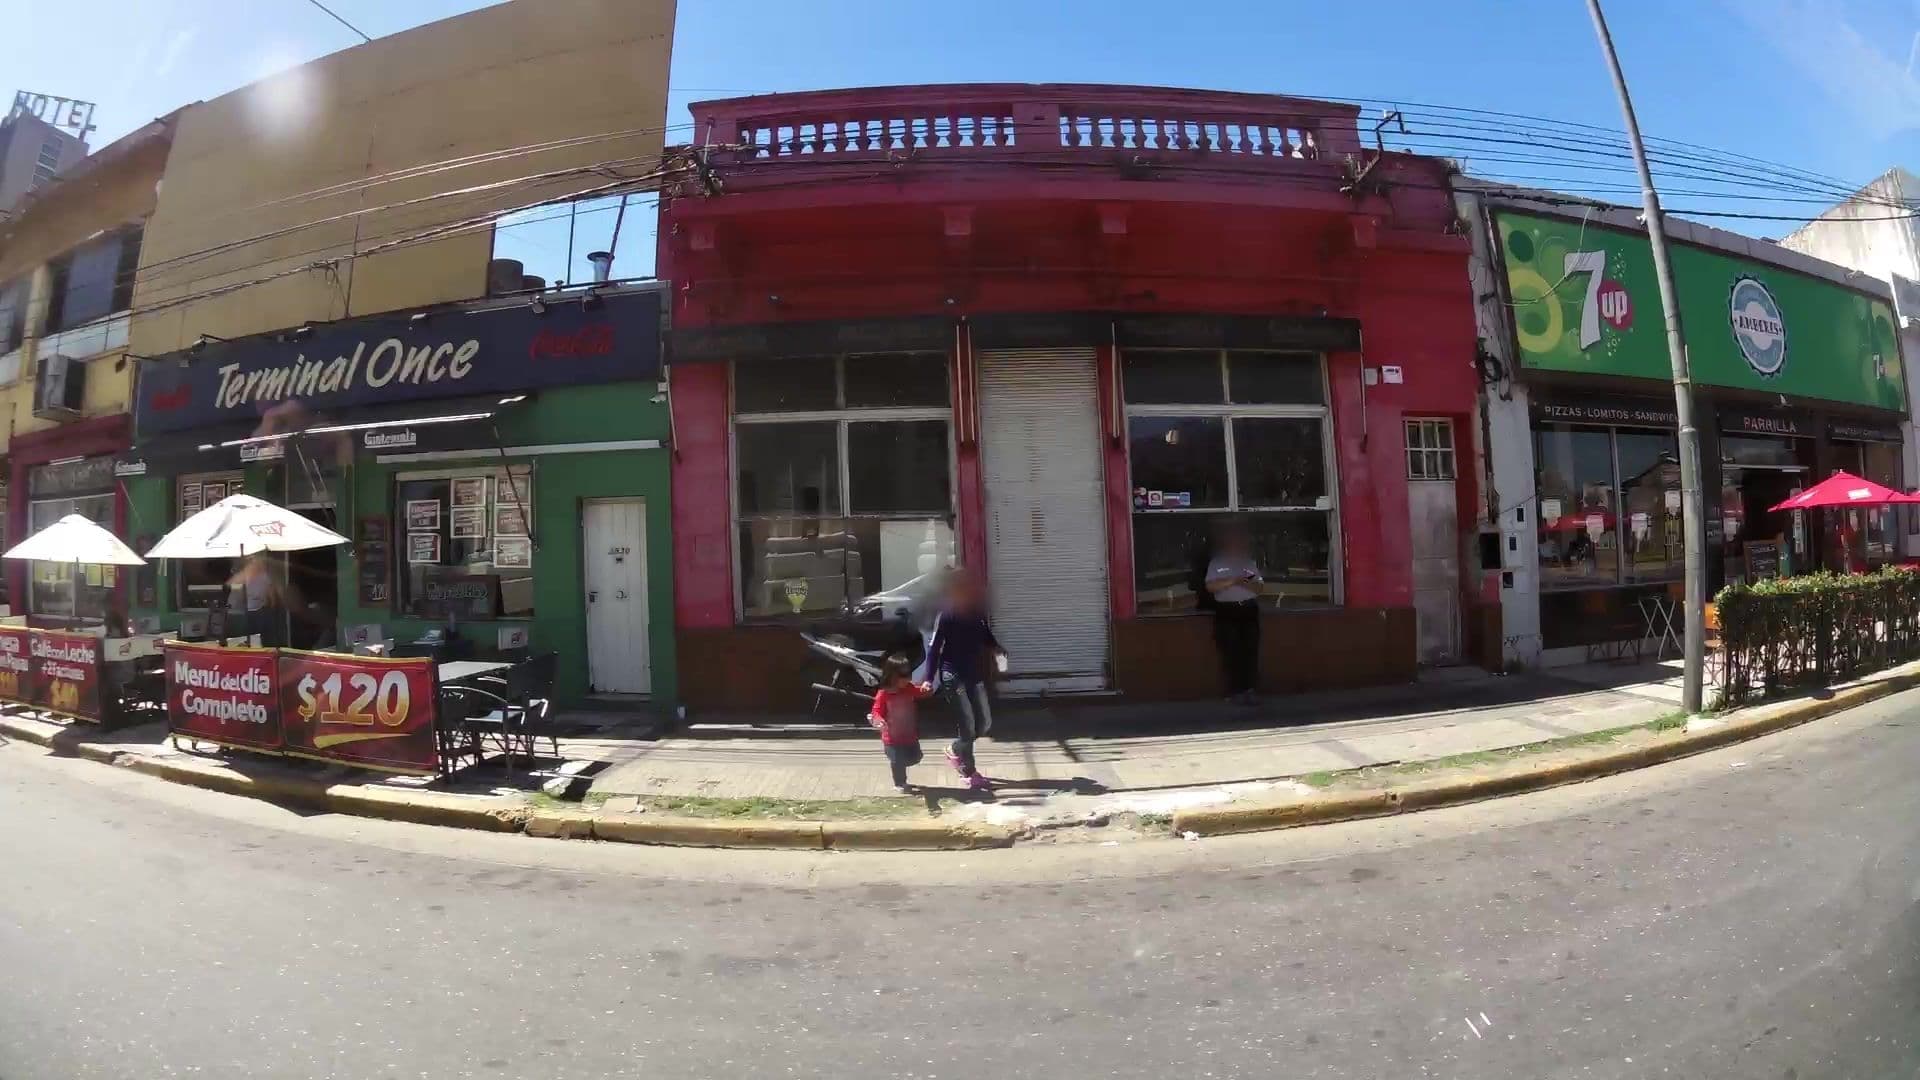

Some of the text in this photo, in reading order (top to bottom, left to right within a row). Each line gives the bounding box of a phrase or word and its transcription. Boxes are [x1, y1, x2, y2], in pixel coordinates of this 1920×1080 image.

[14, 91, 97, 132] HOTEL
[215, 341, 366, 408] Terminal
[366, 338, 480, 388] Once
[1545, 405, 1680, 423] PIZZAS LOMITOS SANDWIC
[1744, 416, 1797, 433] PARRILLA
[175, 661, 270, 695] Menú del día
[182, 689, 267, 724] Completo
[297, 670, 410, 727] $120
